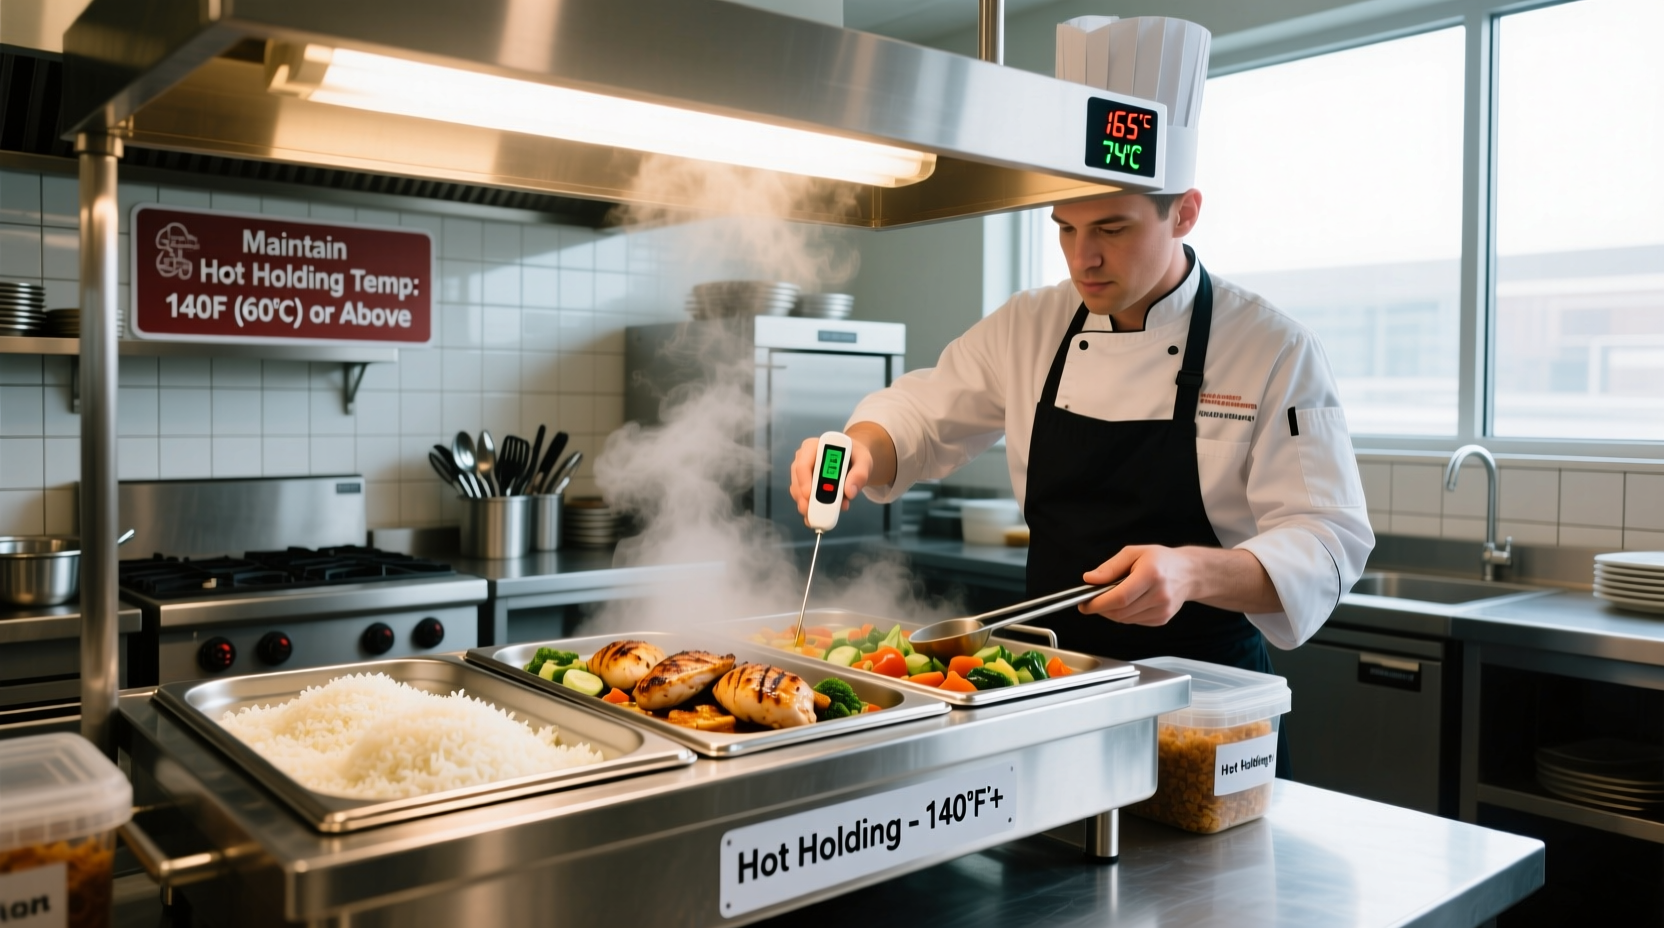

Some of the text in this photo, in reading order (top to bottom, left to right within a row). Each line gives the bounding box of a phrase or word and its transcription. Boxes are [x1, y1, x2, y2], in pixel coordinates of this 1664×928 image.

[242, 229, 347, 260] Maintain
[200, 258, 419, 300] Hot Holding Temp:
[165, 292, 228, 319] 140F
[309, 305, 335, 324] or
[339, 301, 412, 328] Above
[738, 843, 790, 884] Hot
[799, 818, 901, 867] Holding
